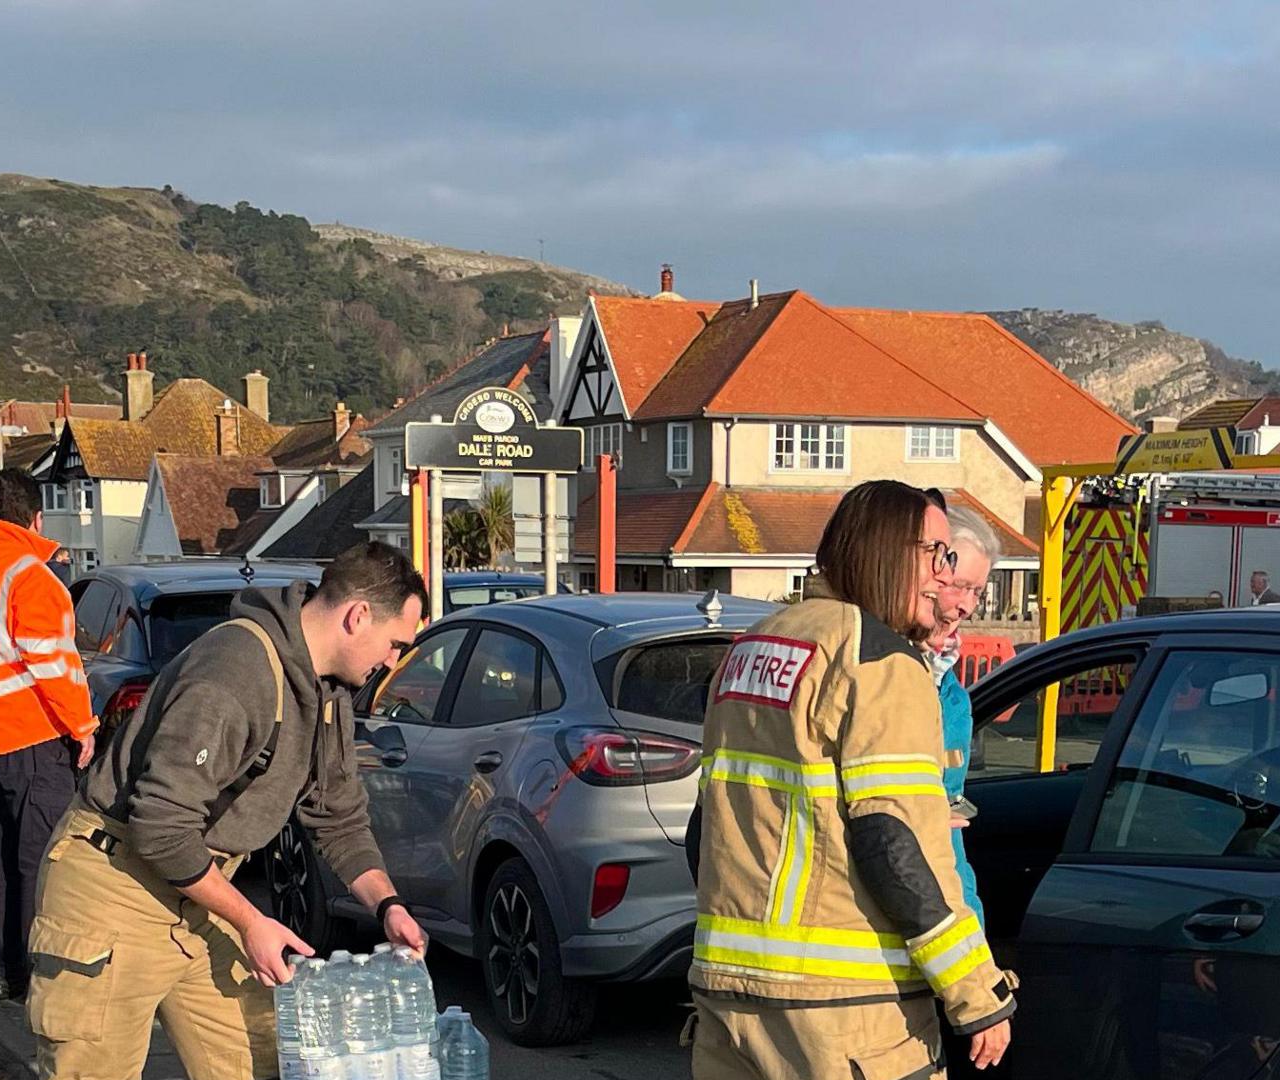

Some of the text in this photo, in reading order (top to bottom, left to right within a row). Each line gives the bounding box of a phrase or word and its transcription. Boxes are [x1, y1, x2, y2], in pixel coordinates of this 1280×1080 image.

[494, 391, 534, 424] WELCOME
[458, 442, 533, 458] DALE ROAD
[1145, 437, 1208, 450] MAXIMUM HEIGHT
[478, 457, 513, 467] CAR PARK
[750, 654, 798, 689] FIRE
